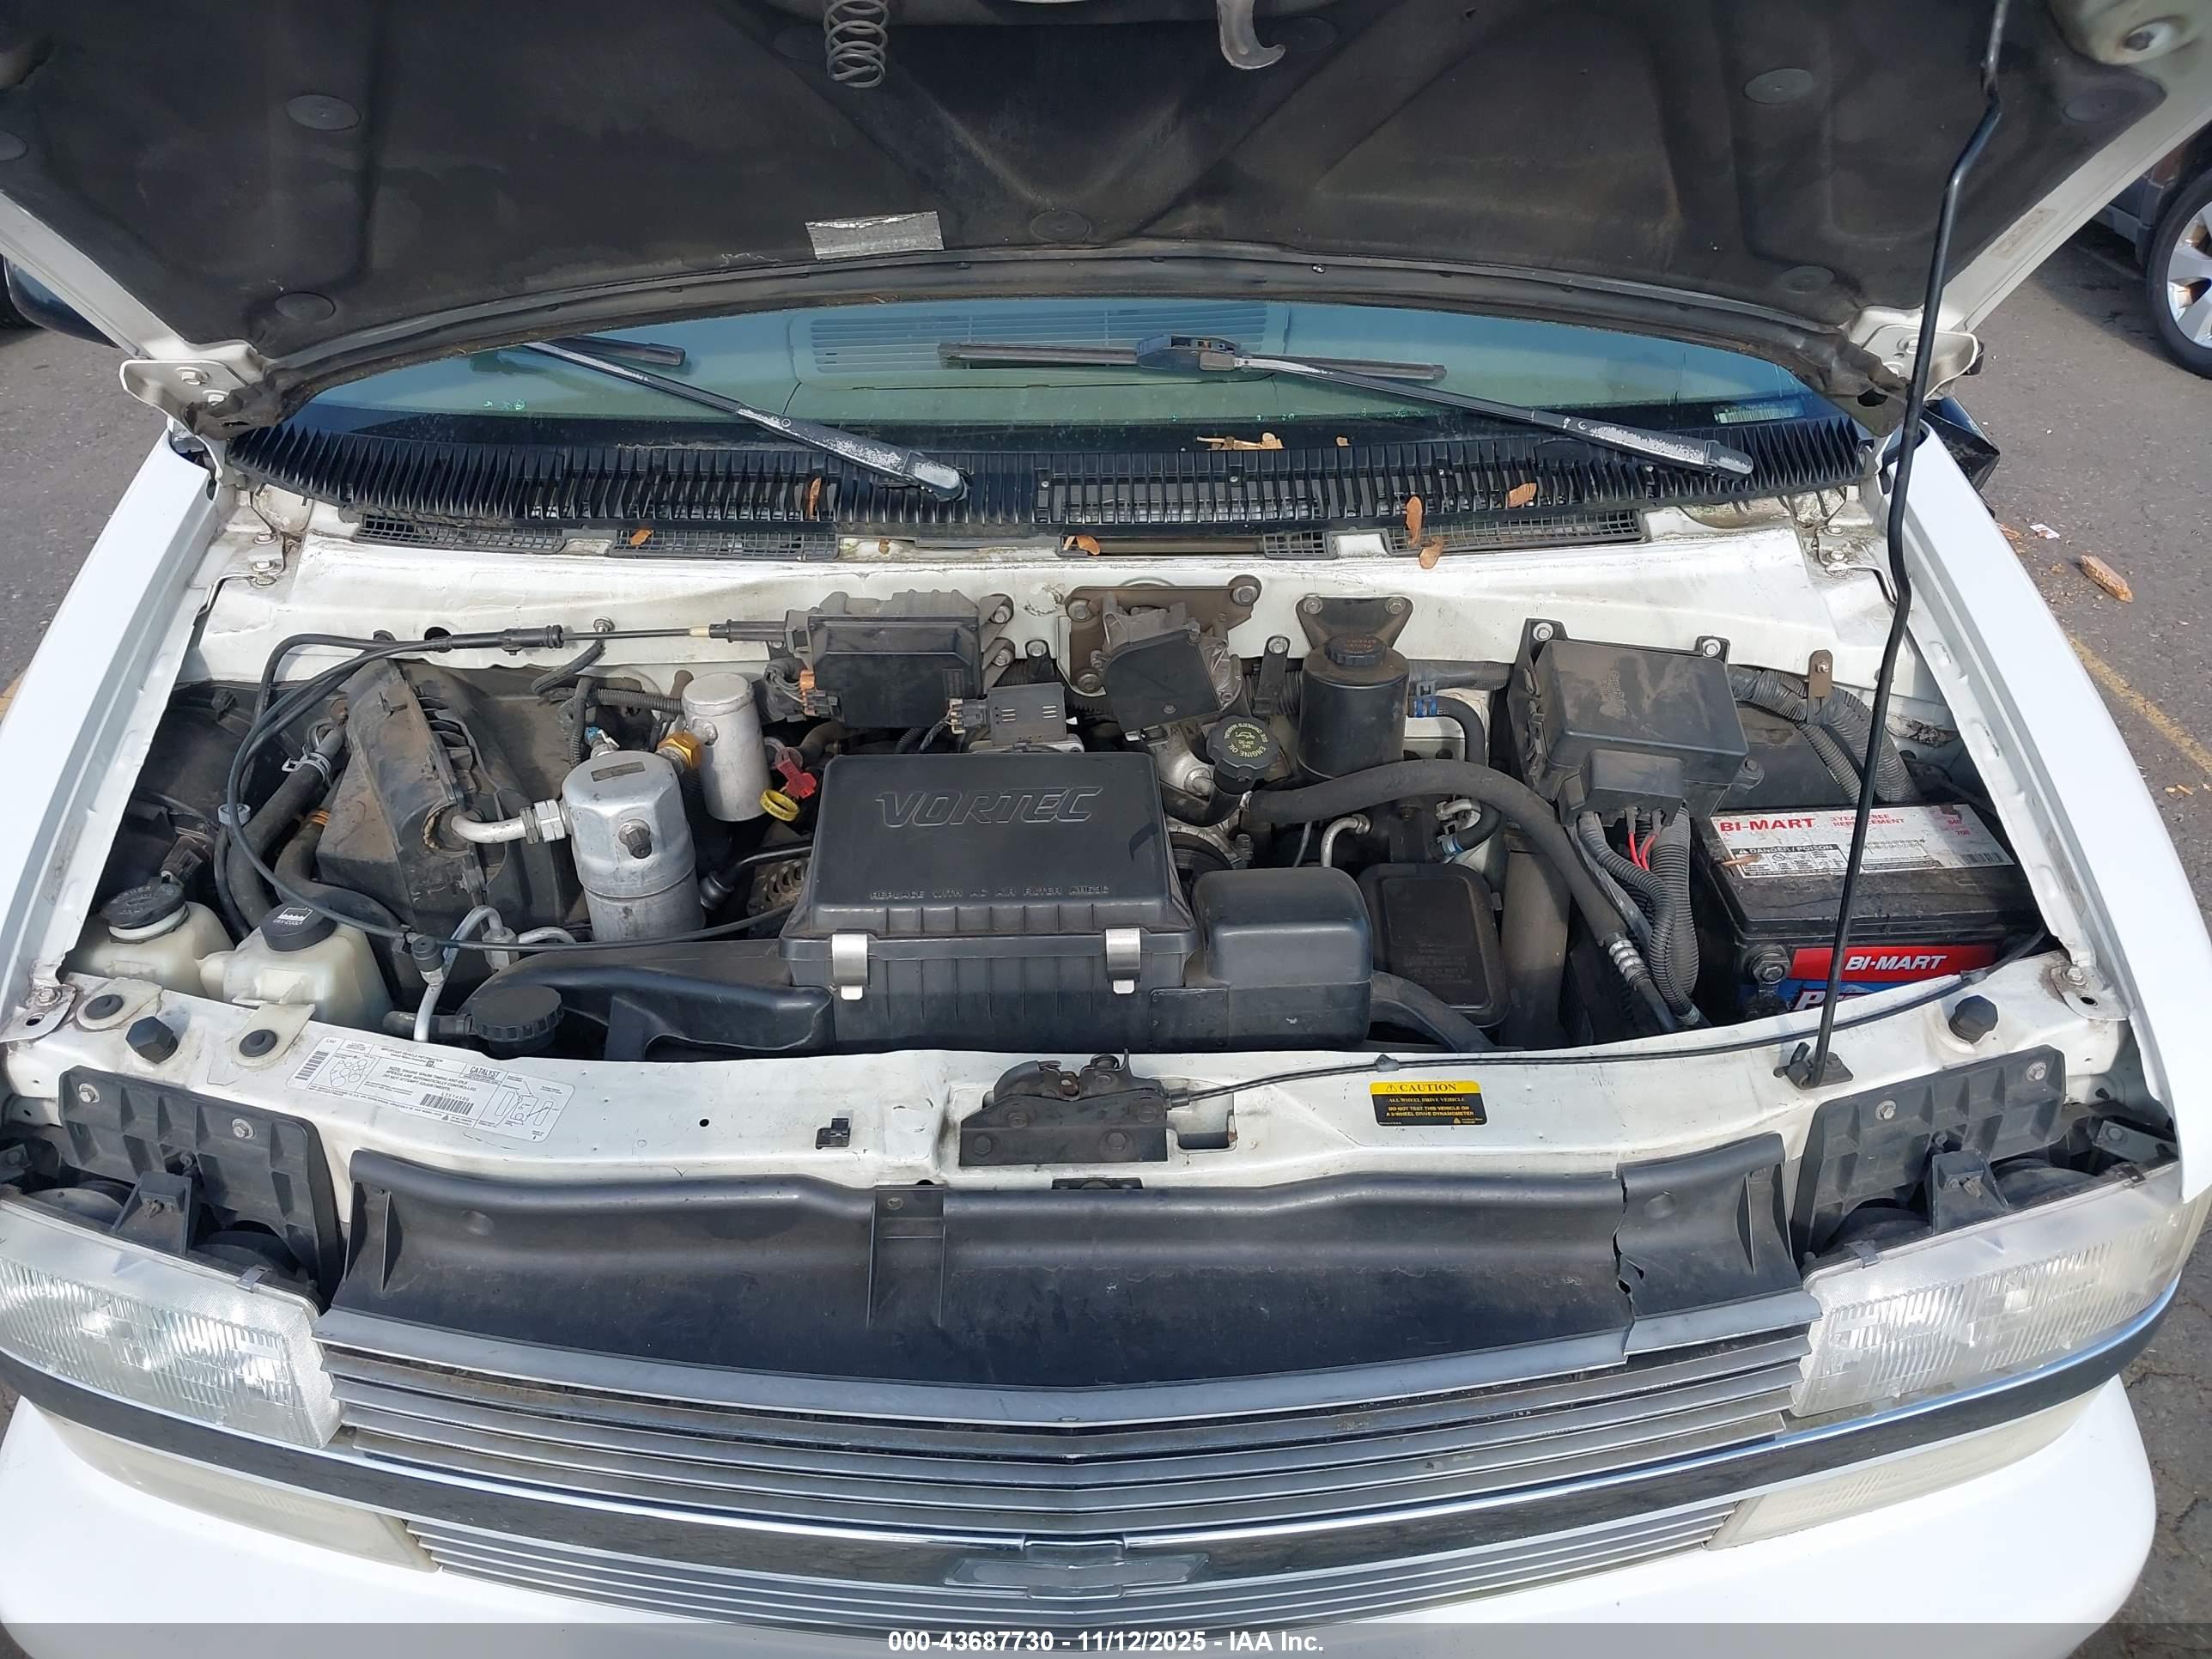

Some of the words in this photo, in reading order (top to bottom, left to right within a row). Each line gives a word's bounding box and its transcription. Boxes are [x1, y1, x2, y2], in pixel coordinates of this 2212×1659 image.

[1228, 743, 1239, 754] OIL
[1239, 745, 1267, 758] ENGINE
[876, 787, 1103, 828] VORTEC
[1720, 817, 1816, 832] BI-MART
[1023, 886, 1061, 896] FILTER
[1844, 955, 1948, 970] BI-MART
[470, 1066, 501, 1078] CATALYST
[1400, 1083, 1457, 1092] CAUTION
